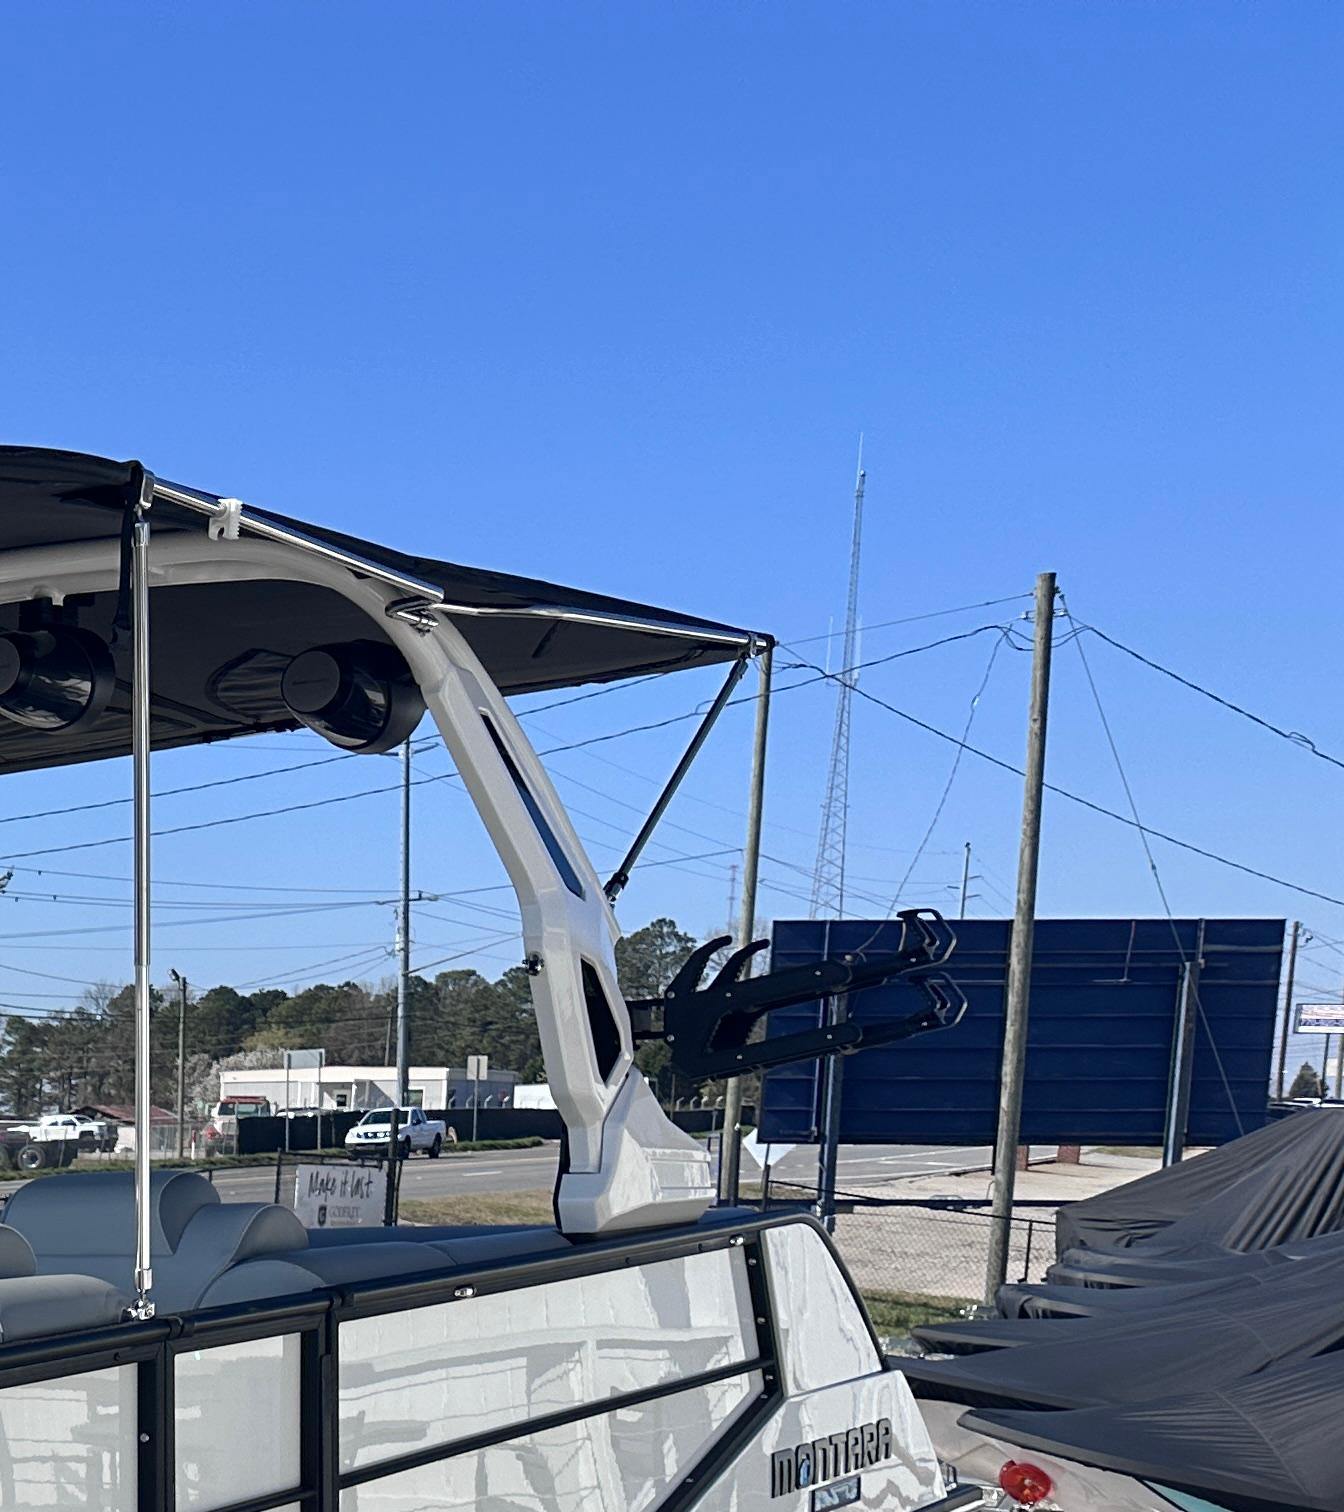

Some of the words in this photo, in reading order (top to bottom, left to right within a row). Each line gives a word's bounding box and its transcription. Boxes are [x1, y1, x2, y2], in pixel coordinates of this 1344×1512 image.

[308, 1170, 336, 1202] Make
[340, 1170, 349, 1198] it
[771, 1418, 893, 1498] MONTARA
